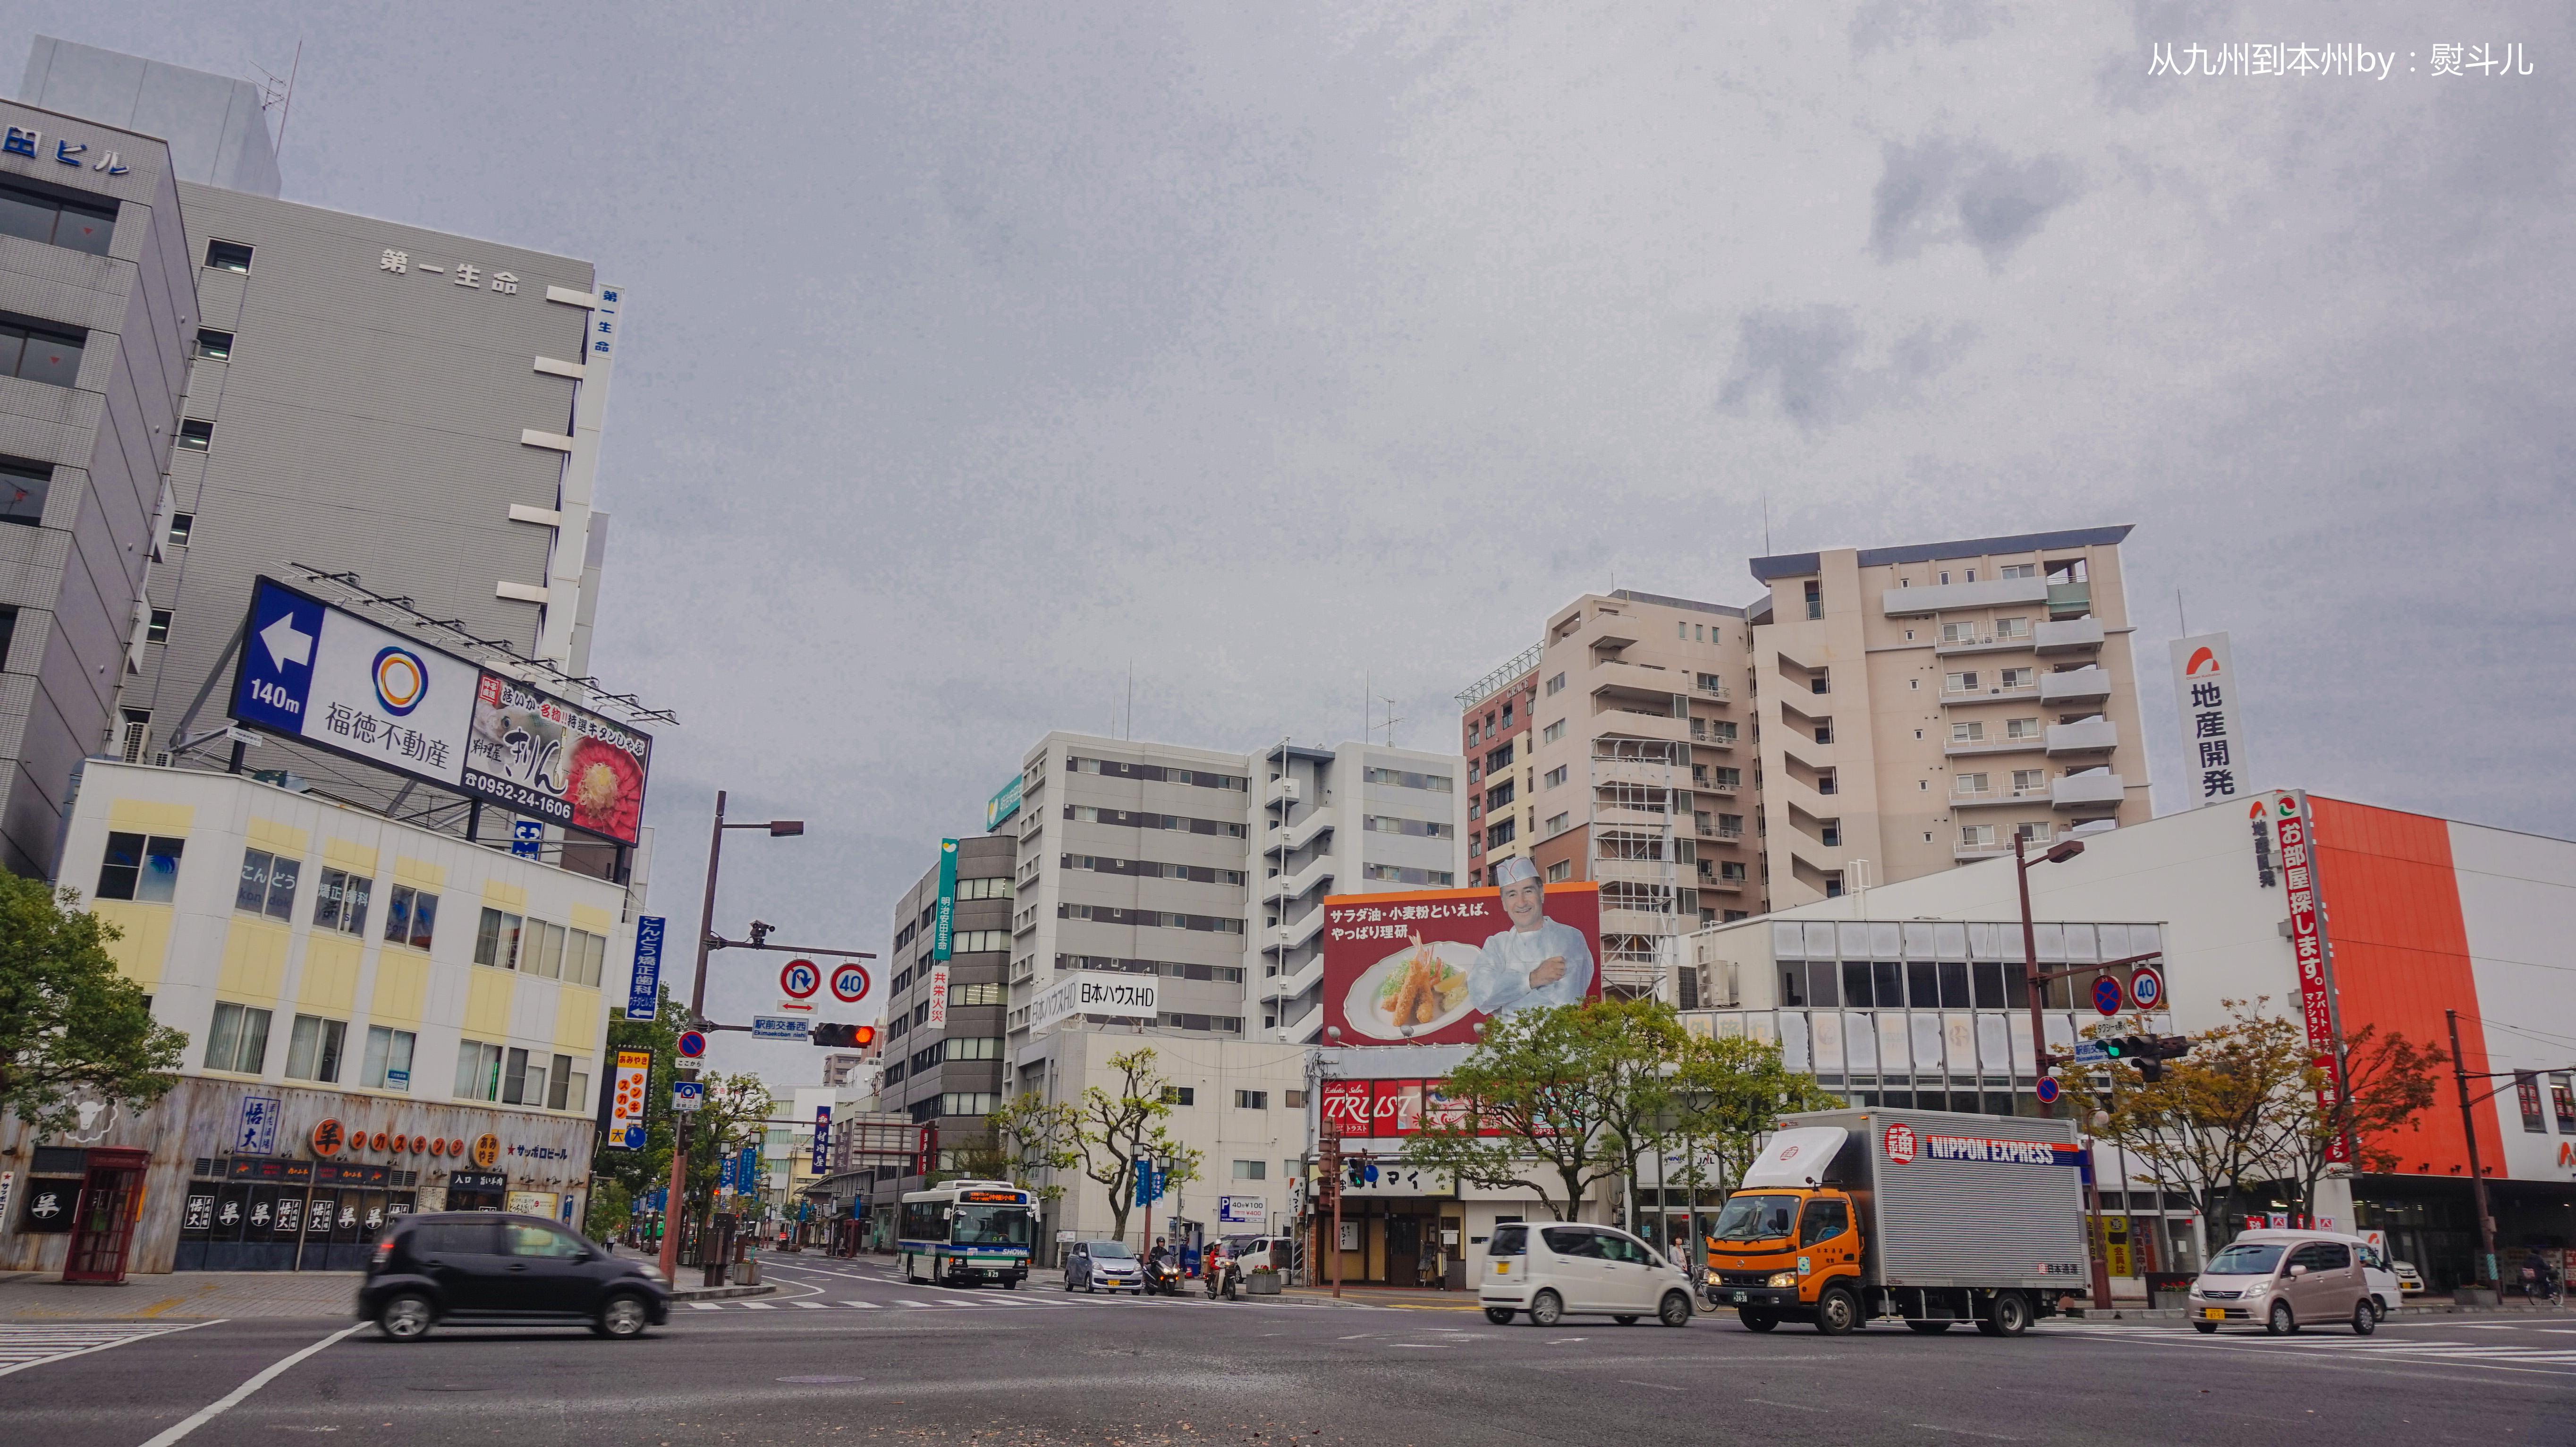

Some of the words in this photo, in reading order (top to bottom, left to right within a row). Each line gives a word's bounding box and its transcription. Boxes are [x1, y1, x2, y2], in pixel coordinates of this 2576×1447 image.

[380, 248, 519, 295] 第一生命
[594, 290, 618, 353] 第一生命
[251, 678, 300, 714] 140m
[325, 702, 450, 770] 福徳不動産
[2191, 682, 2235, 798] 地産開発
[471, 738, 503, 763] 料理屋
[478, 775, 570, 819] 0952-24-1606
[241, 865, 295, 889] こんどう
[319, 883, 368, 907] 矯正歯科
[1330, 902, 1490, 923] サラダ油・小麦粉といえば、
[2281, 822, 2323, 986] お部屋探します。
[938, 897, 950, 950] 明治安田生命
[1331, 924, 1408, 941] やっぱり理研
[839, 975, 861, 992] 40
[1081, 983, 1154, 1007] 日本ハウスHD
[2137, 979, 2154, 998] 40
[932, 972, 946, 1022] 共栄火災
[754, 1030, 791, 1038] Ekimaekoban
[755, 1019, 806, 1031] 駅前交番西
[619, 1055, 647, 1065] あみやき
[316, 1123, 340, 1152] 羊
[813, 1131, 827, 1167] 村岡屋
[517, 1144, 568, 1160] サッポロビール
[1932, 1136, 1988, 1160] NIPPON
[1992, 1141, 2053, 1164] EXPRESS
[455, 1175, 472, 1183] 入口
[480, 1176, 503, 1186] 旨い羊肉
[33, 1194, 60, 1217] 羊
[187, 1198, 203, 1226] 悟大
[220, 1202, 239, 1224] 羊
[251, 1204, 271, 1225] 羊
[277, 1201, 291, 1228] 悟大
[1222, 1198, 1229, 1209] P
[310, 1203, 324, 1229] 悟大
[338, 1207, 356, 1227] 羊
[365, 1208, 382, 1228] 羊
